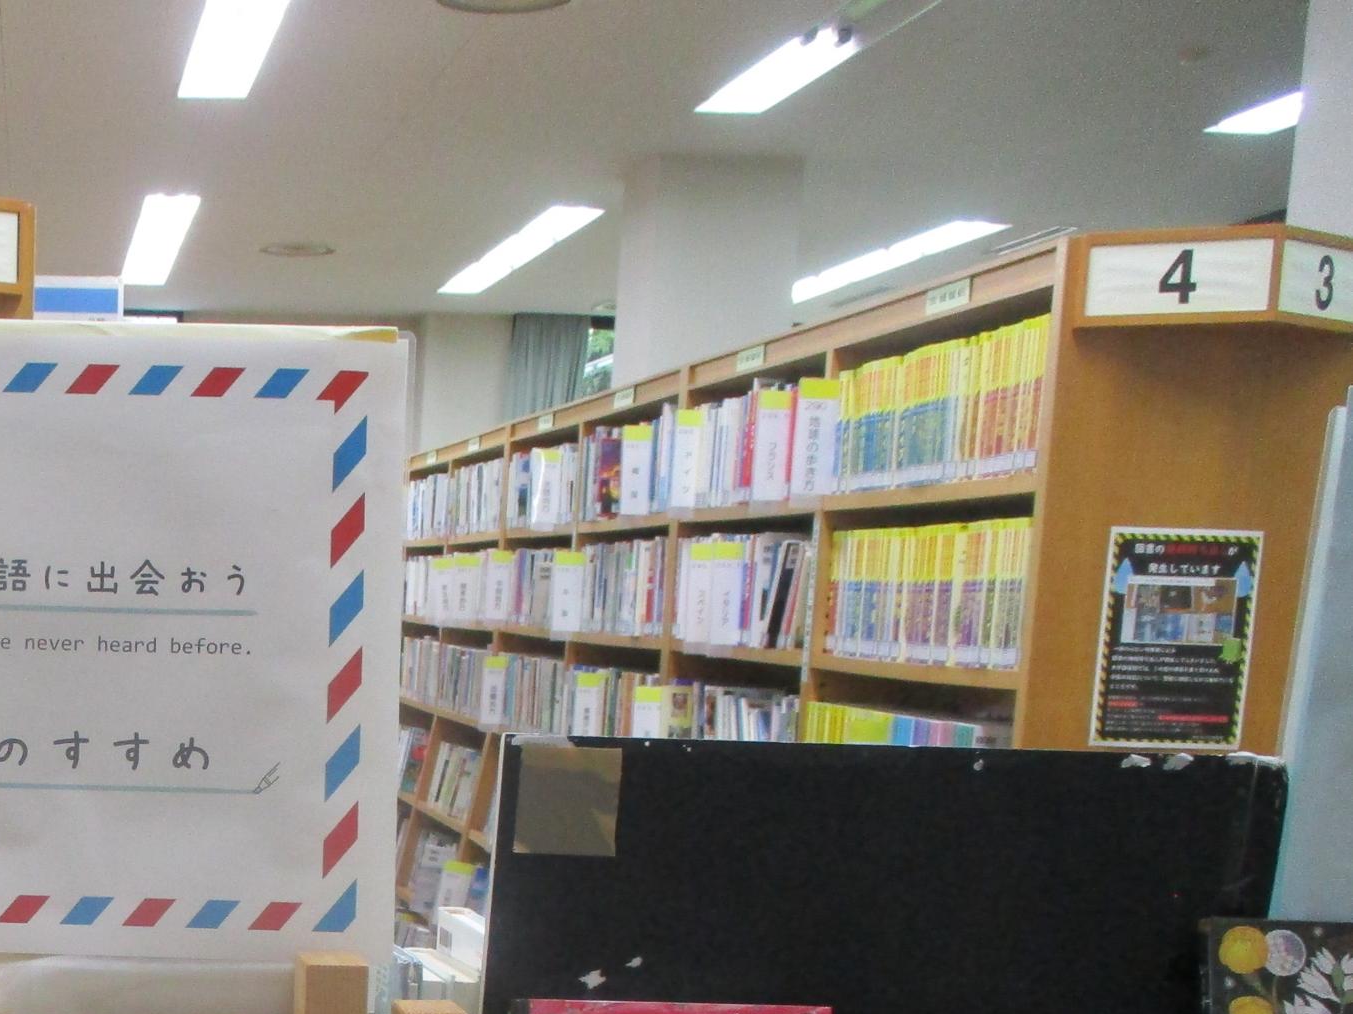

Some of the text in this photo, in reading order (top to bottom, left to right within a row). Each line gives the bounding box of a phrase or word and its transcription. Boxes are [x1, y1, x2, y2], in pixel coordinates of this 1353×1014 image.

[1158, 248, 1197, 306] 4
[1314, 253, 1336, 312] 3
[24, 636, 85, 654] never
[97, 633, 159, 655] heard
[169, 635, 253, 657] before.
